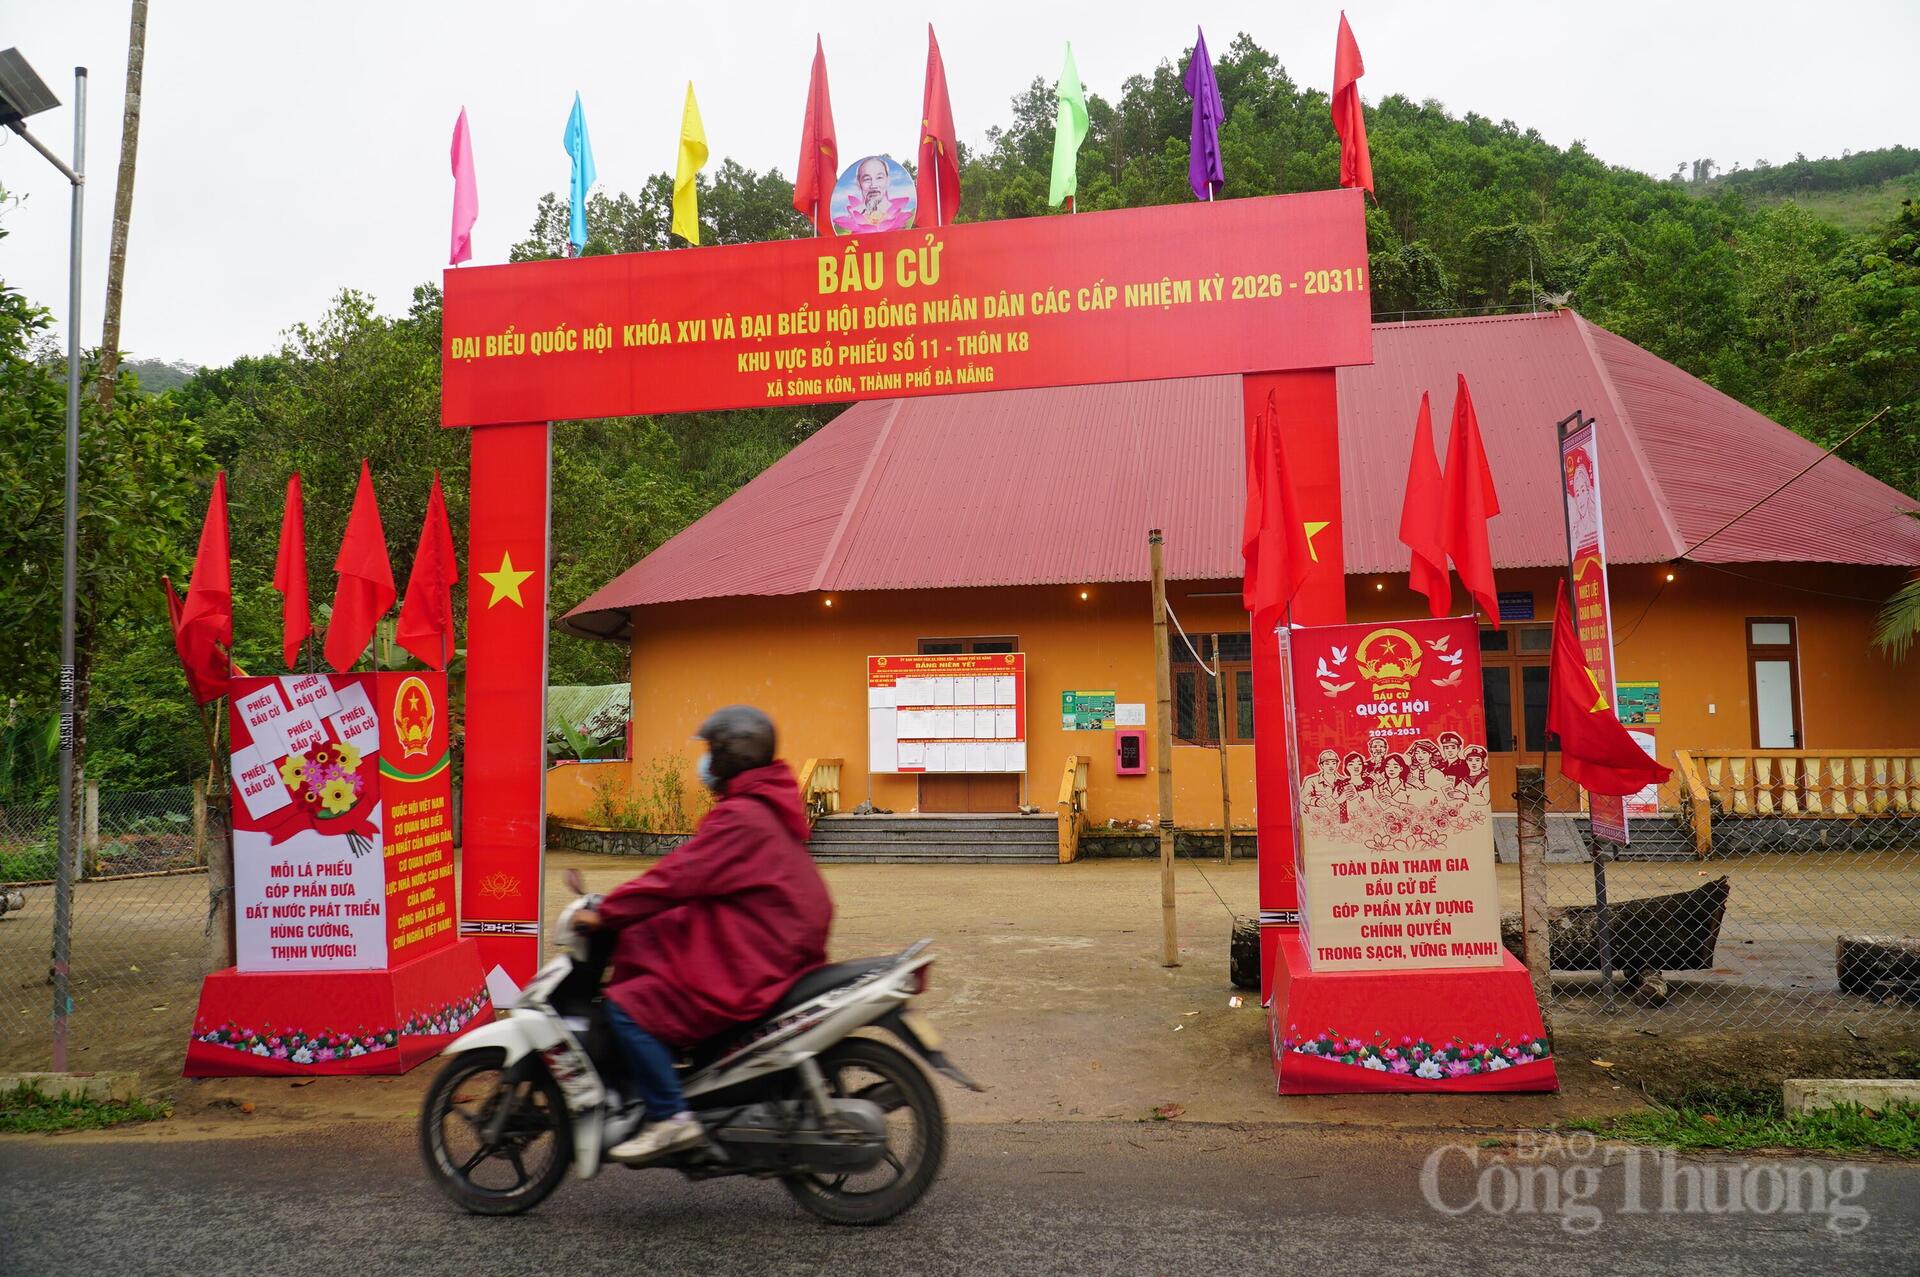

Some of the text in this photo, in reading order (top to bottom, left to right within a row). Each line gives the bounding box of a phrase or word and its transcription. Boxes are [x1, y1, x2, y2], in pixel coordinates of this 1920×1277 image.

[818, 234, 944, 294] BẦU CỬ
[452, 336, 480, 363] ĐẠI
[486, 324, 525, 356] BIỂU
[530, 322, 577, 356] QUỐC
[583, 322, 612, 354] HỘI
[623, 318, 672, 346] KHÓA
[678, 320, 706, 342] XVI
[712, 313, 736, 340] VÀ
[741, 314, 772, 342] ĐẠI
[778, 302, 821, 336] BIỂU
[827, 304, 858, 336] HỘI
[864, 298, 916, 328] ĐỒNG
[924, 294, 978, 324] NHÂN
[984, 290, 1024, 318] DÂN
[1031, 286, 1071, 316] CÁC
[1077, 278, 1118, 312] CẤP
[1124, 277, 1192, 310] NHIỆM
[1198, 272, 1224, 302] KỲ
[1231, 274, 1283, 300] 2026
[1304, 267, 1364, 294] 2031!
[738, 350, 770, 372] KHU
[774, 348, 806, 374] VỰC
[812, 340, 832, 368] BỎ
[839, 338, 888, 366] PHIẾU
[892, 333, 914, 362] SỐ
[920, 339, 938, 359] 11
[957, 331, 1002, 356] THÔN
[1008, 332, 1029, 352] K8
[767, 362, 994, 398] XÃ SÔNG KÔN, THÀNH PHỐ ĐÀ NẴNG
[292, 675, 319, 694] PHIẾU
[247, 694, 272, 712] PHIẾU
[1356, 699, 1430, 716] QUỐC HỘI
[340, 706, 366, 725] PHIẾU
[363, 716, 375, 730] CỬ
[1377, 714, 1412, 728] XVI
[287, 720, 312, 738] PHIẾU
[1369, 728, 1420, 737] 2026-2031
[241, 763, 266, 782] PHIẾU
[263, 774, 276, 788] CỬ
[271, 859, 352, 878] MỖI LÁ PHIẾU
[1331, 858, 1469, 876] TOÀN DÂN THAM GIA
[266, 880, 355, 898] GÓP PHẦN ĐƯA
[1366, 875, 1437, 896] BẦU CỬ ĐỂ
[246, 898, 380, 919] ĐẤT NƯỚC PHÁT TRIỂN
[1332, 899, 1474, 918] GÓP PHẦN XÂY DỰNG
[270, 922, 353, 938] HÙNG CƯỜNG,
[1361, 919, 1452, 938] CHÍNH QUYỀN
[271, 944, 356, 961] THỊNH VƯỢNG!
[1317, 941, 1498, 962] TRONG SẠCH, VỮNG MẠNH!
